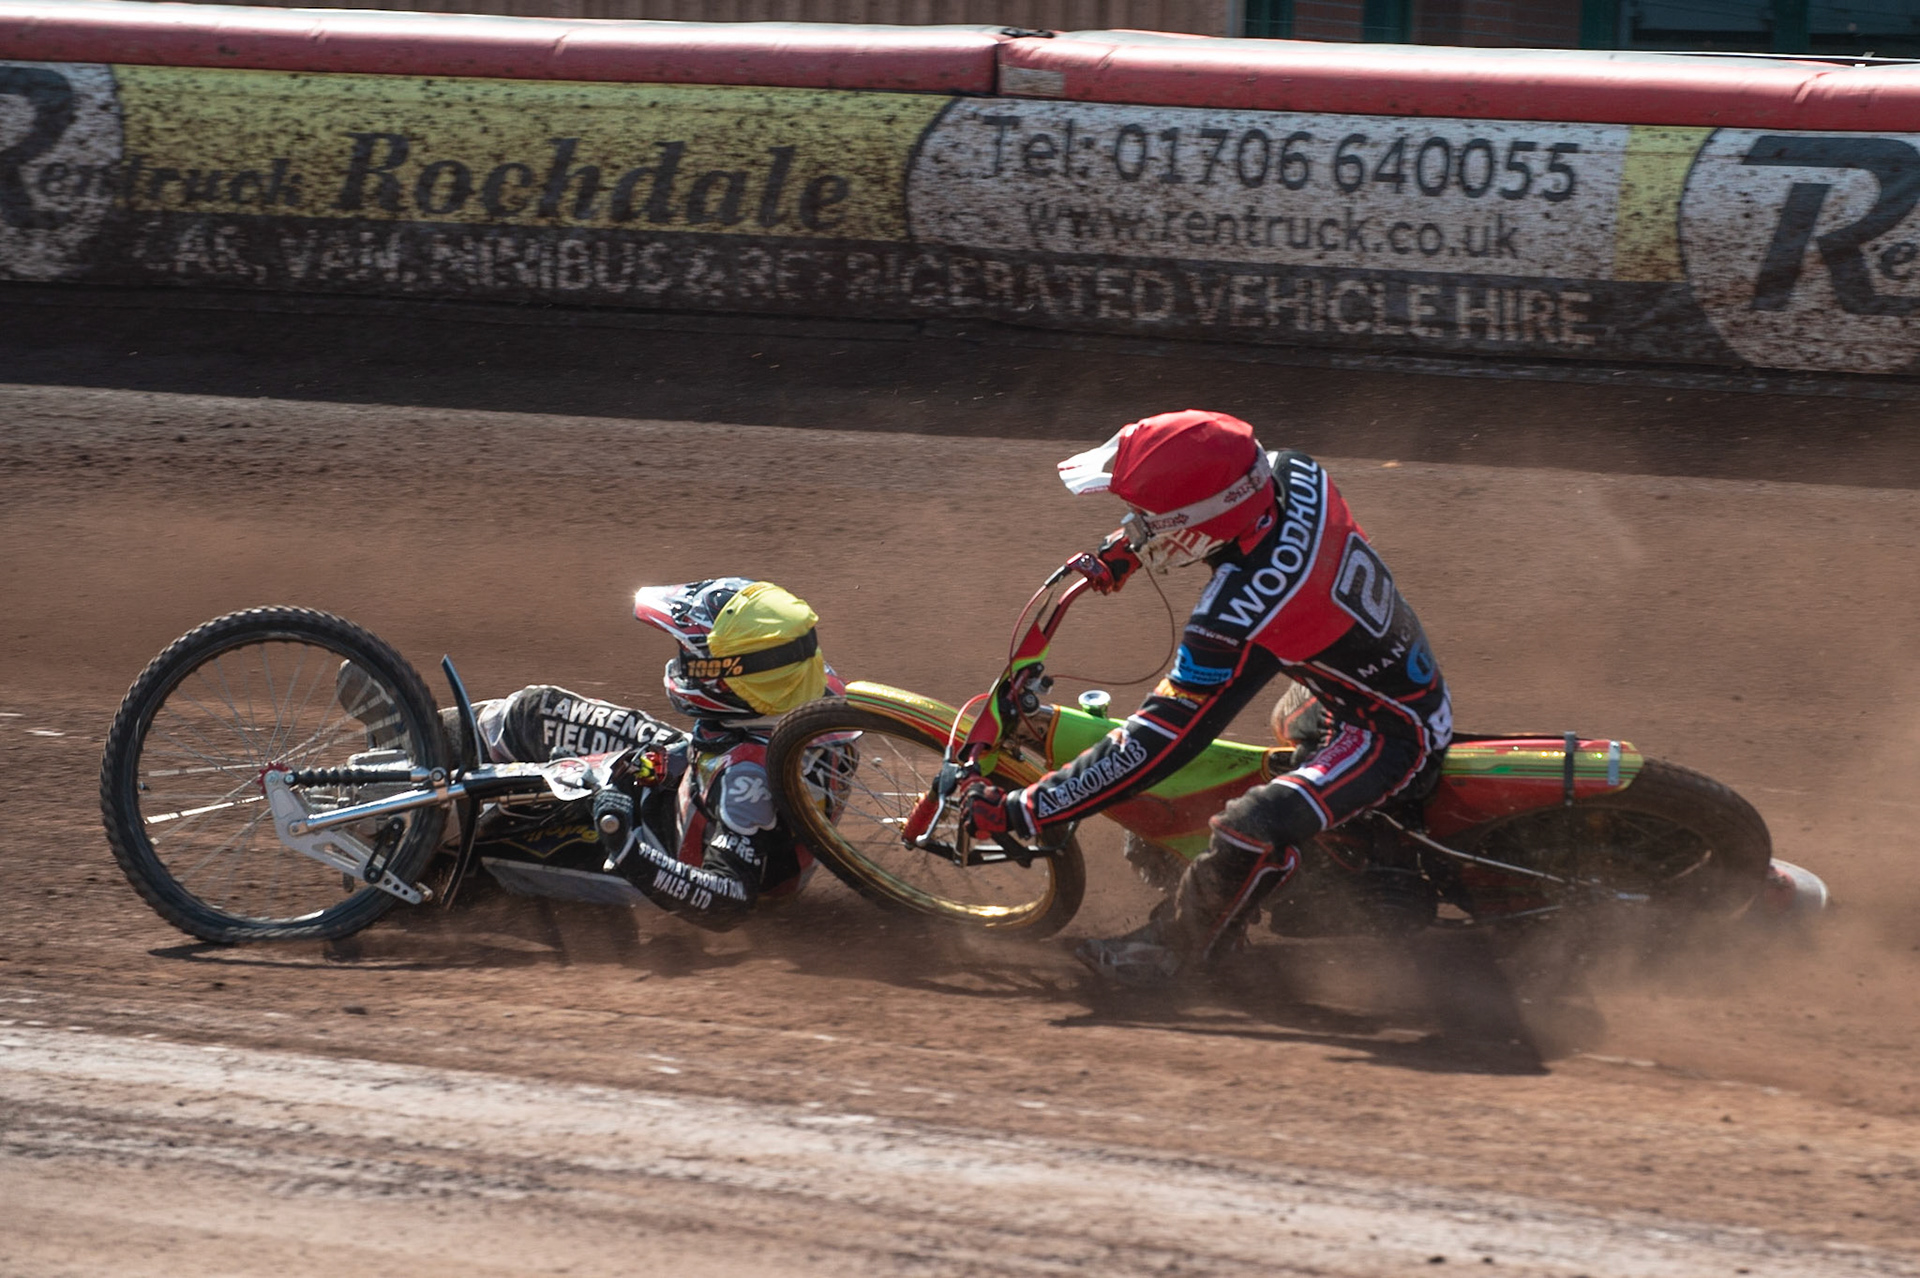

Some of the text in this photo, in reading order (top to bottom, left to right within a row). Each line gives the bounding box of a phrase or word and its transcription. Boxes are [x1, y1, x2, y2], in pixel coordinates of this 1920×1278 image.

[330, 132, 849, 230] Rochdale
[982, 115, 1580, 202] Tel: 01706 640055
[1024, 200, 1520, 260] www.rentruck.co.uk
[1186, 272, 1445, 341] VEHICLE
[1456, 285, 1598, 346] HIRE
[1217, 457, 1319, 628] WOODHULL
[1338, 549, 1392, 626] 2
[686, 656, 743, 678] 100%
[539, 690, 674, 746] LAWRENCE
[542, 719, 634, 755] FIELDIN
[638, 842, 748, 902] SPEEDWAY PROMOTION
[652, 869, 713, 910] WALES LTD
